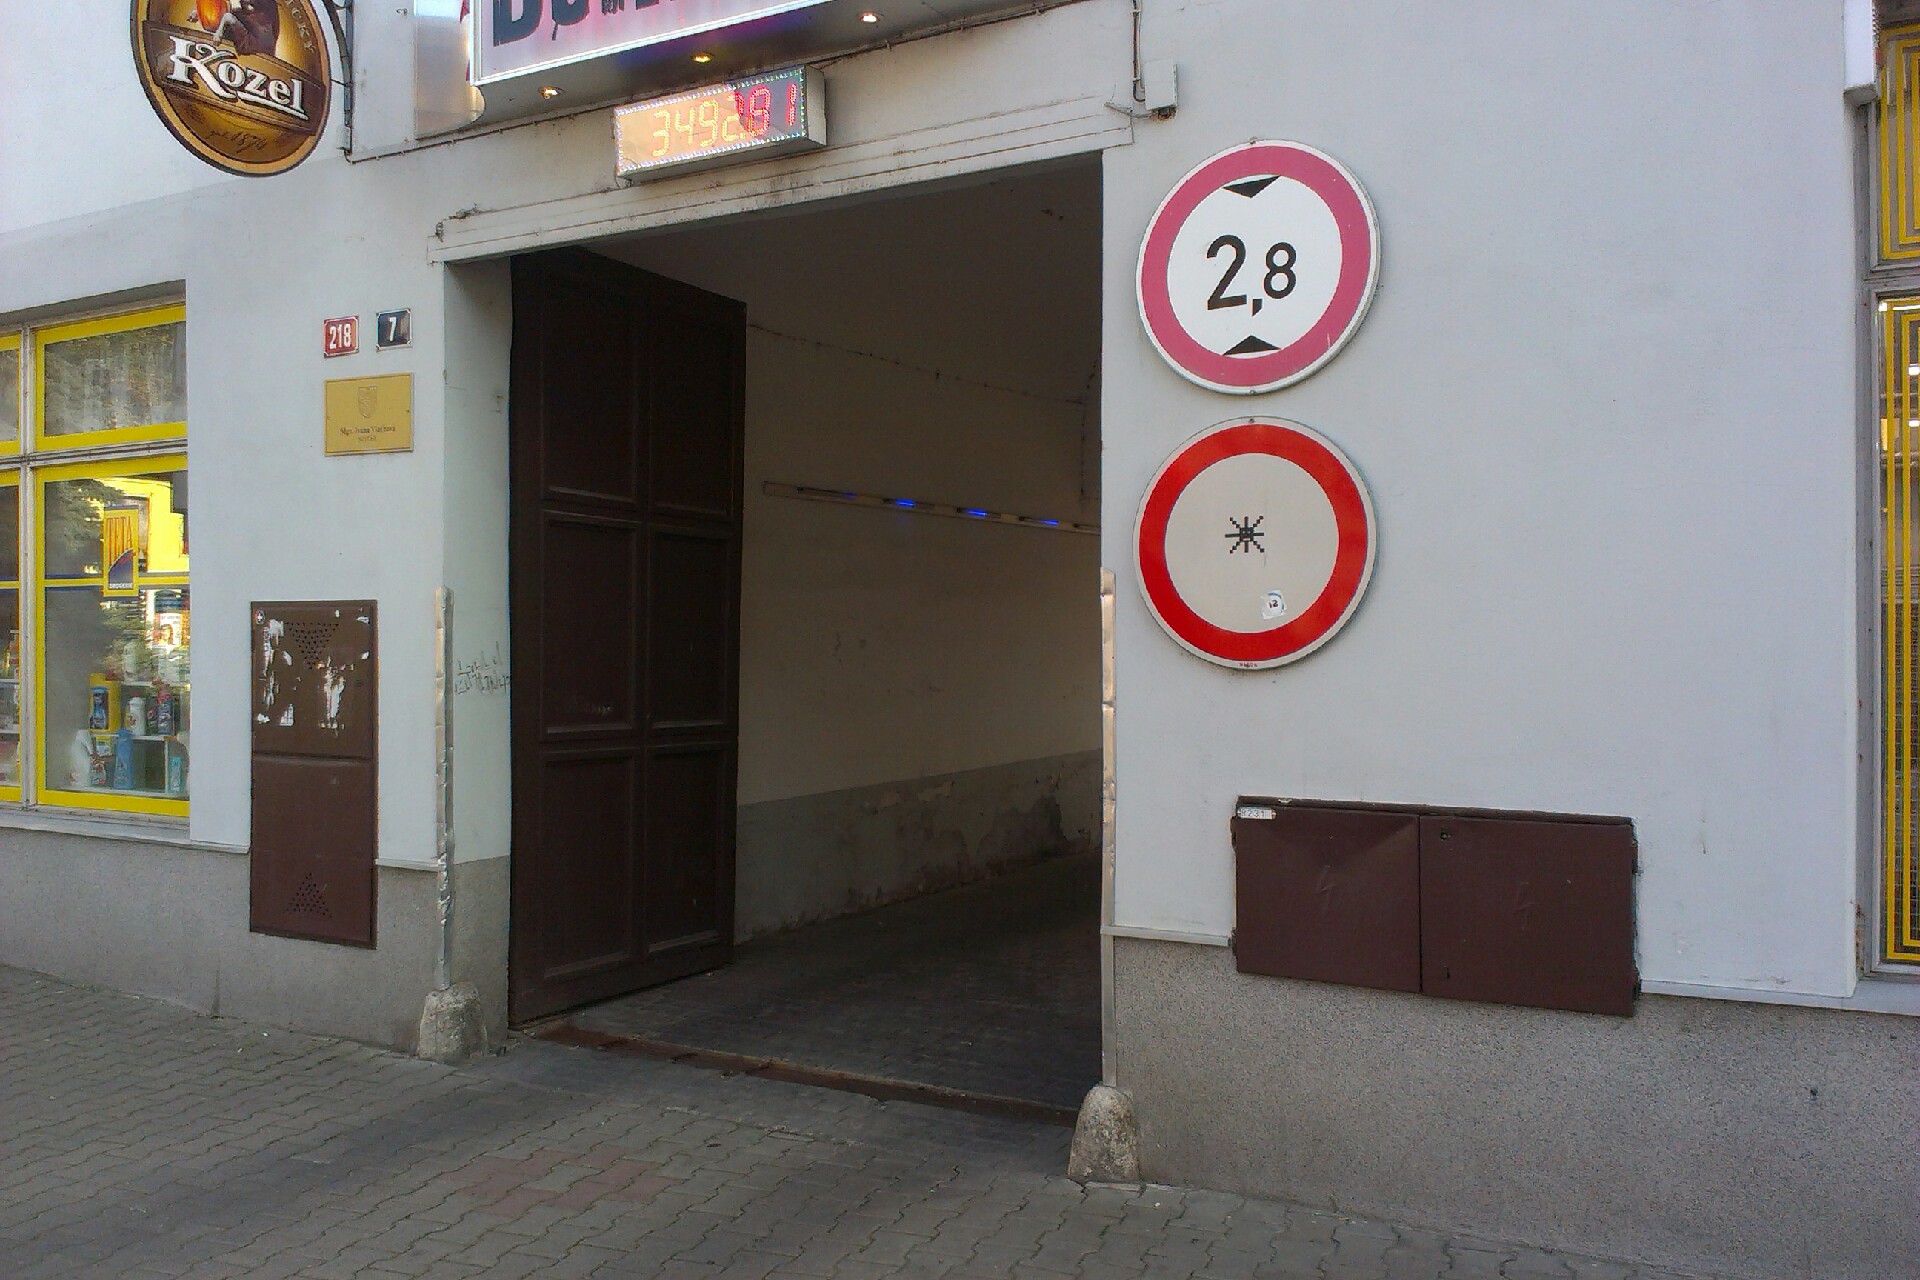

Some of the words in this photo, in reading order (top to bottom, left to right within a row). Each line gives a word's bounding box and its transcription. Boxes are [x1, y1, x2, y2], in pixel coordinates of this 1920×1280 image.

[167, 36, 309, 119] Kozel
[1206, 234, 1297, 317] 2,8
[329, 323, 351, 350] 218
[389, 316, 398, 342] 7
